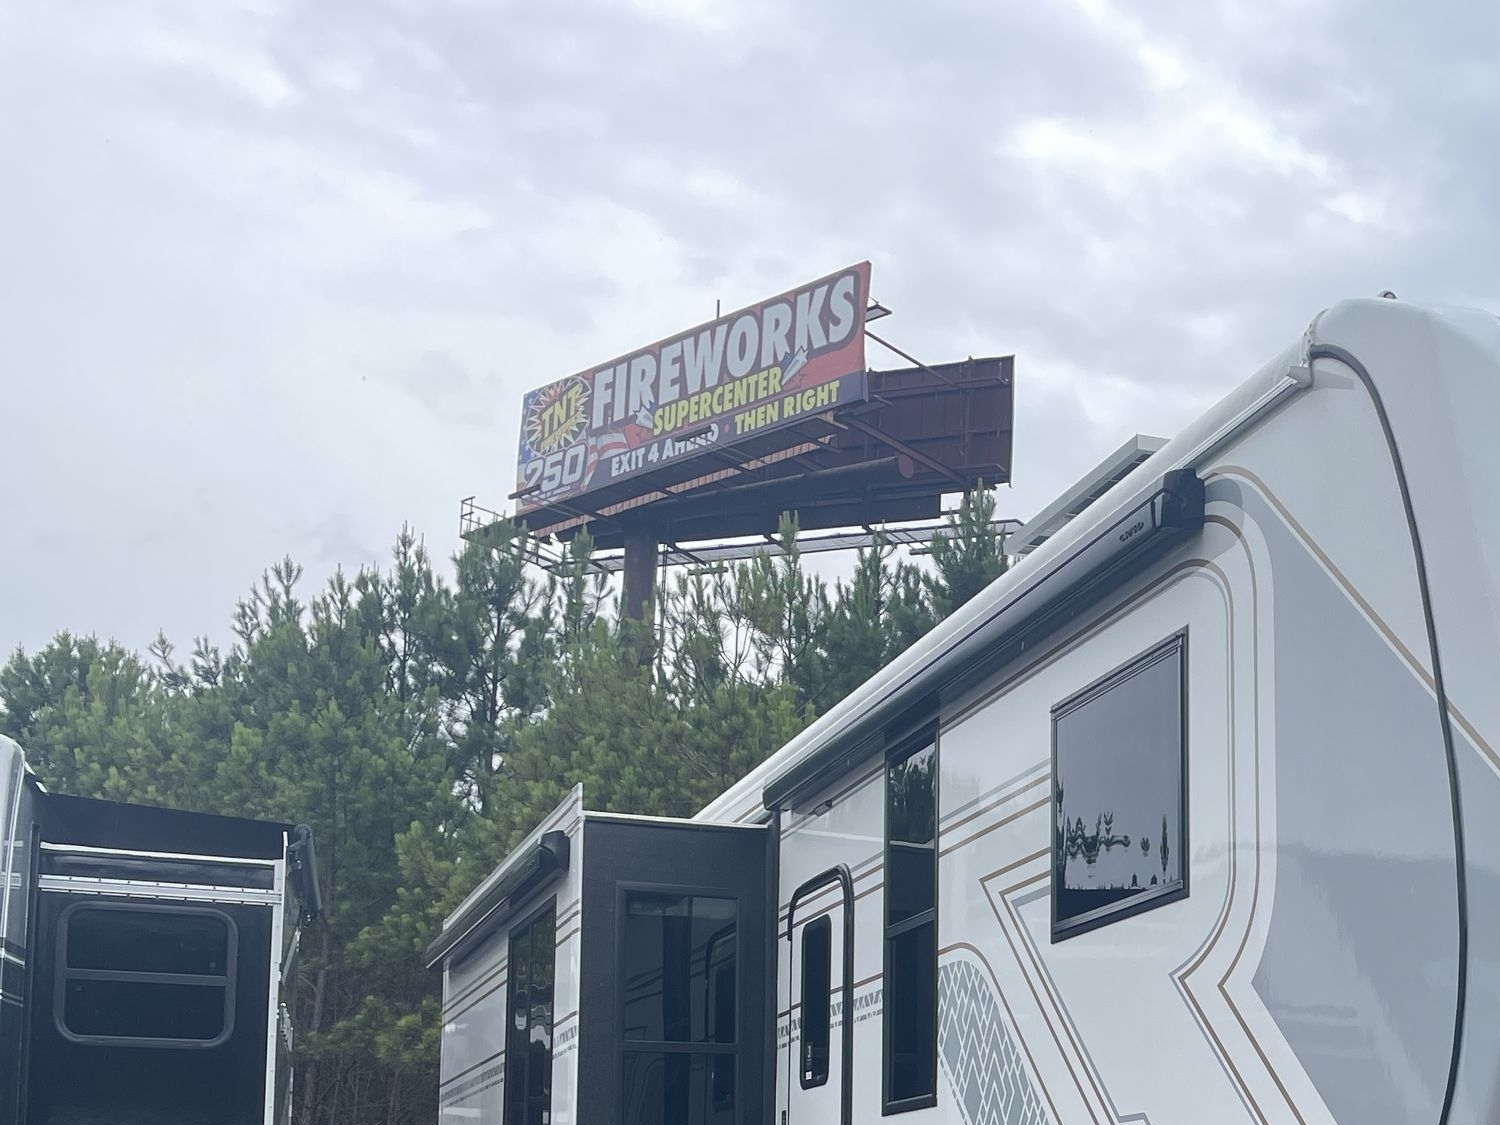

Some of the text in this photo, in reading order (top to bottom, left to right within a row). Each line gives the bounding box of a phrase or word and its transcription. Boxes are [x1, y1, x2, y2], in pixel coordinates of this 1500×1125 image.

[591, 275, 855, 430] FIREWORKS
[541, 382, 583, 440] TNT
[611, 447, 645, 477] EXIT
[647, 442, 659, 463] 4
[734, 400, 780, 435] THEN
[783, 380, 841, 419] RIGHT
[653, 366, 783, 436] SUPERCENTER
[525, 443, 586, 492] 250
